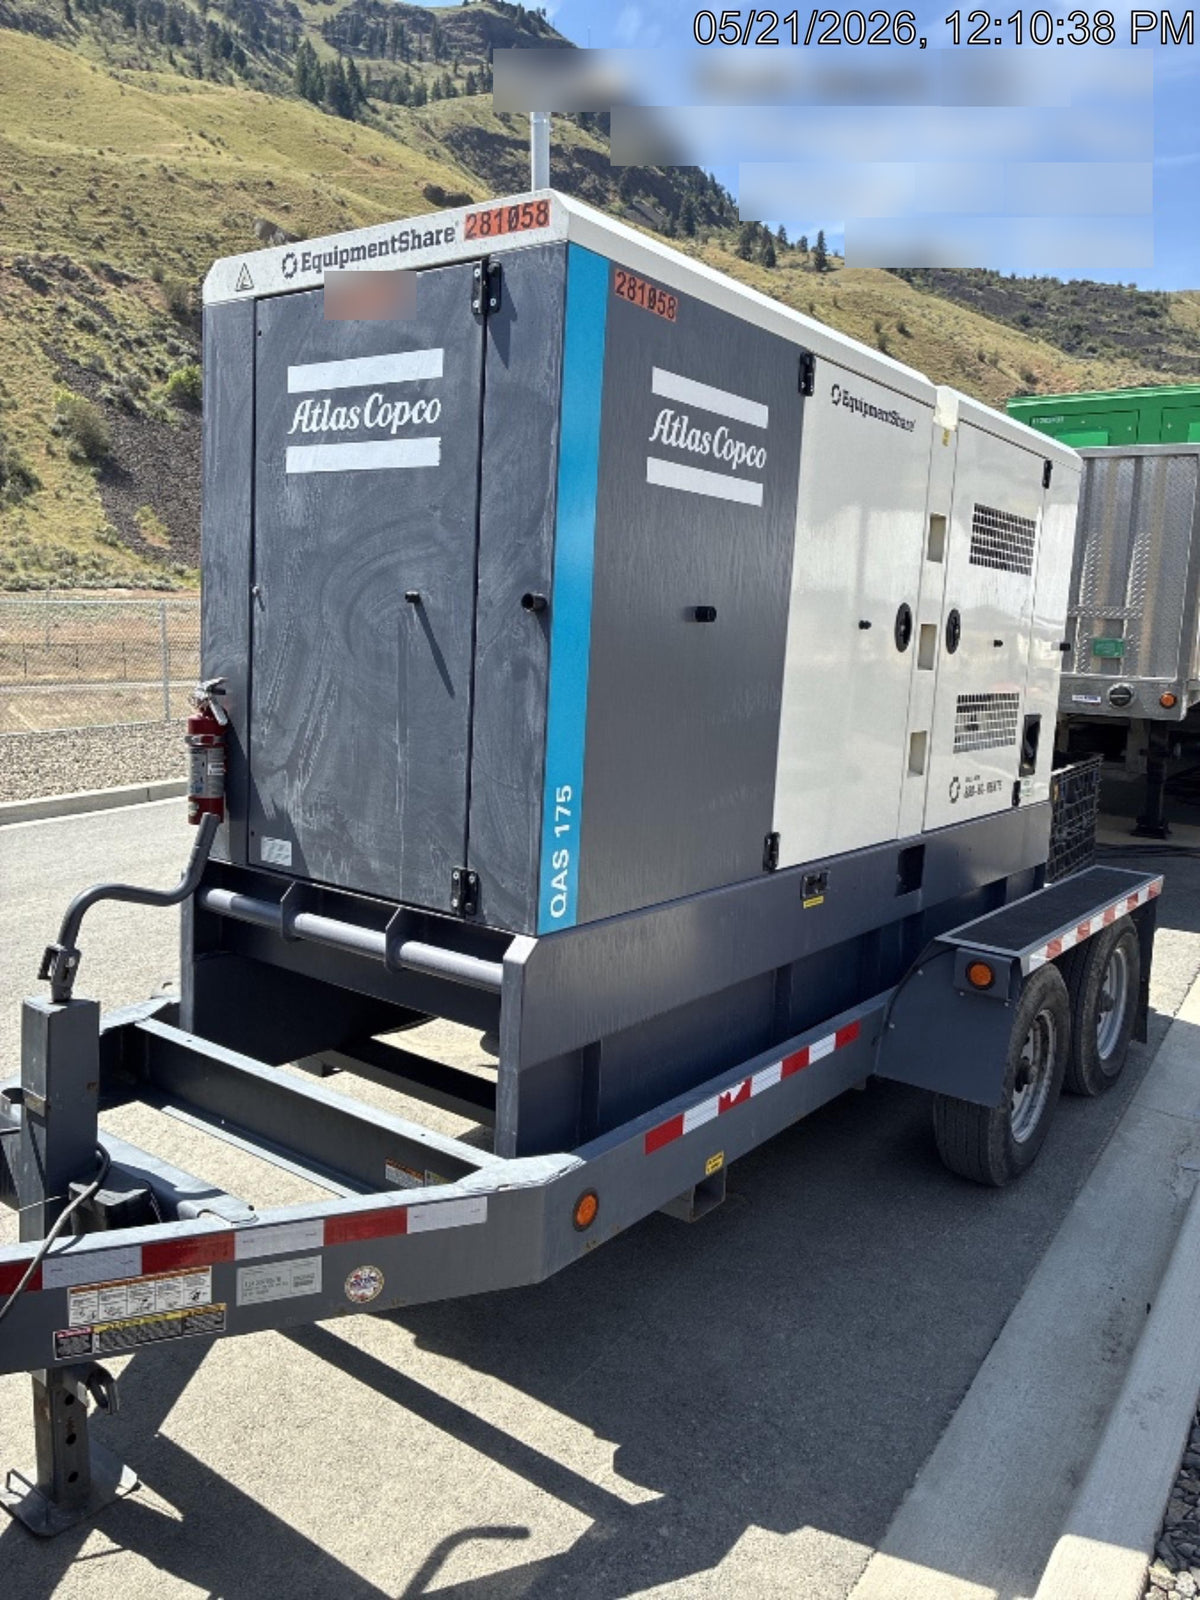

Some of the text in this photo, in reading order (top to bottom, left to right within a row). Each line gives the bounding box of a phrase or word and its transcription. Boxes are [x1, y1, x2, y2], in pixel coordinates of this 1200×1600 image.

[467, 201, 549, 237] 281058
[301, 226, 456, 274] EquipmentShare
[616, 271, 676, 319] 281058
[842, 389, 915, 432] EquipmentShare
[550, 785, 572, 918] QAS 175
